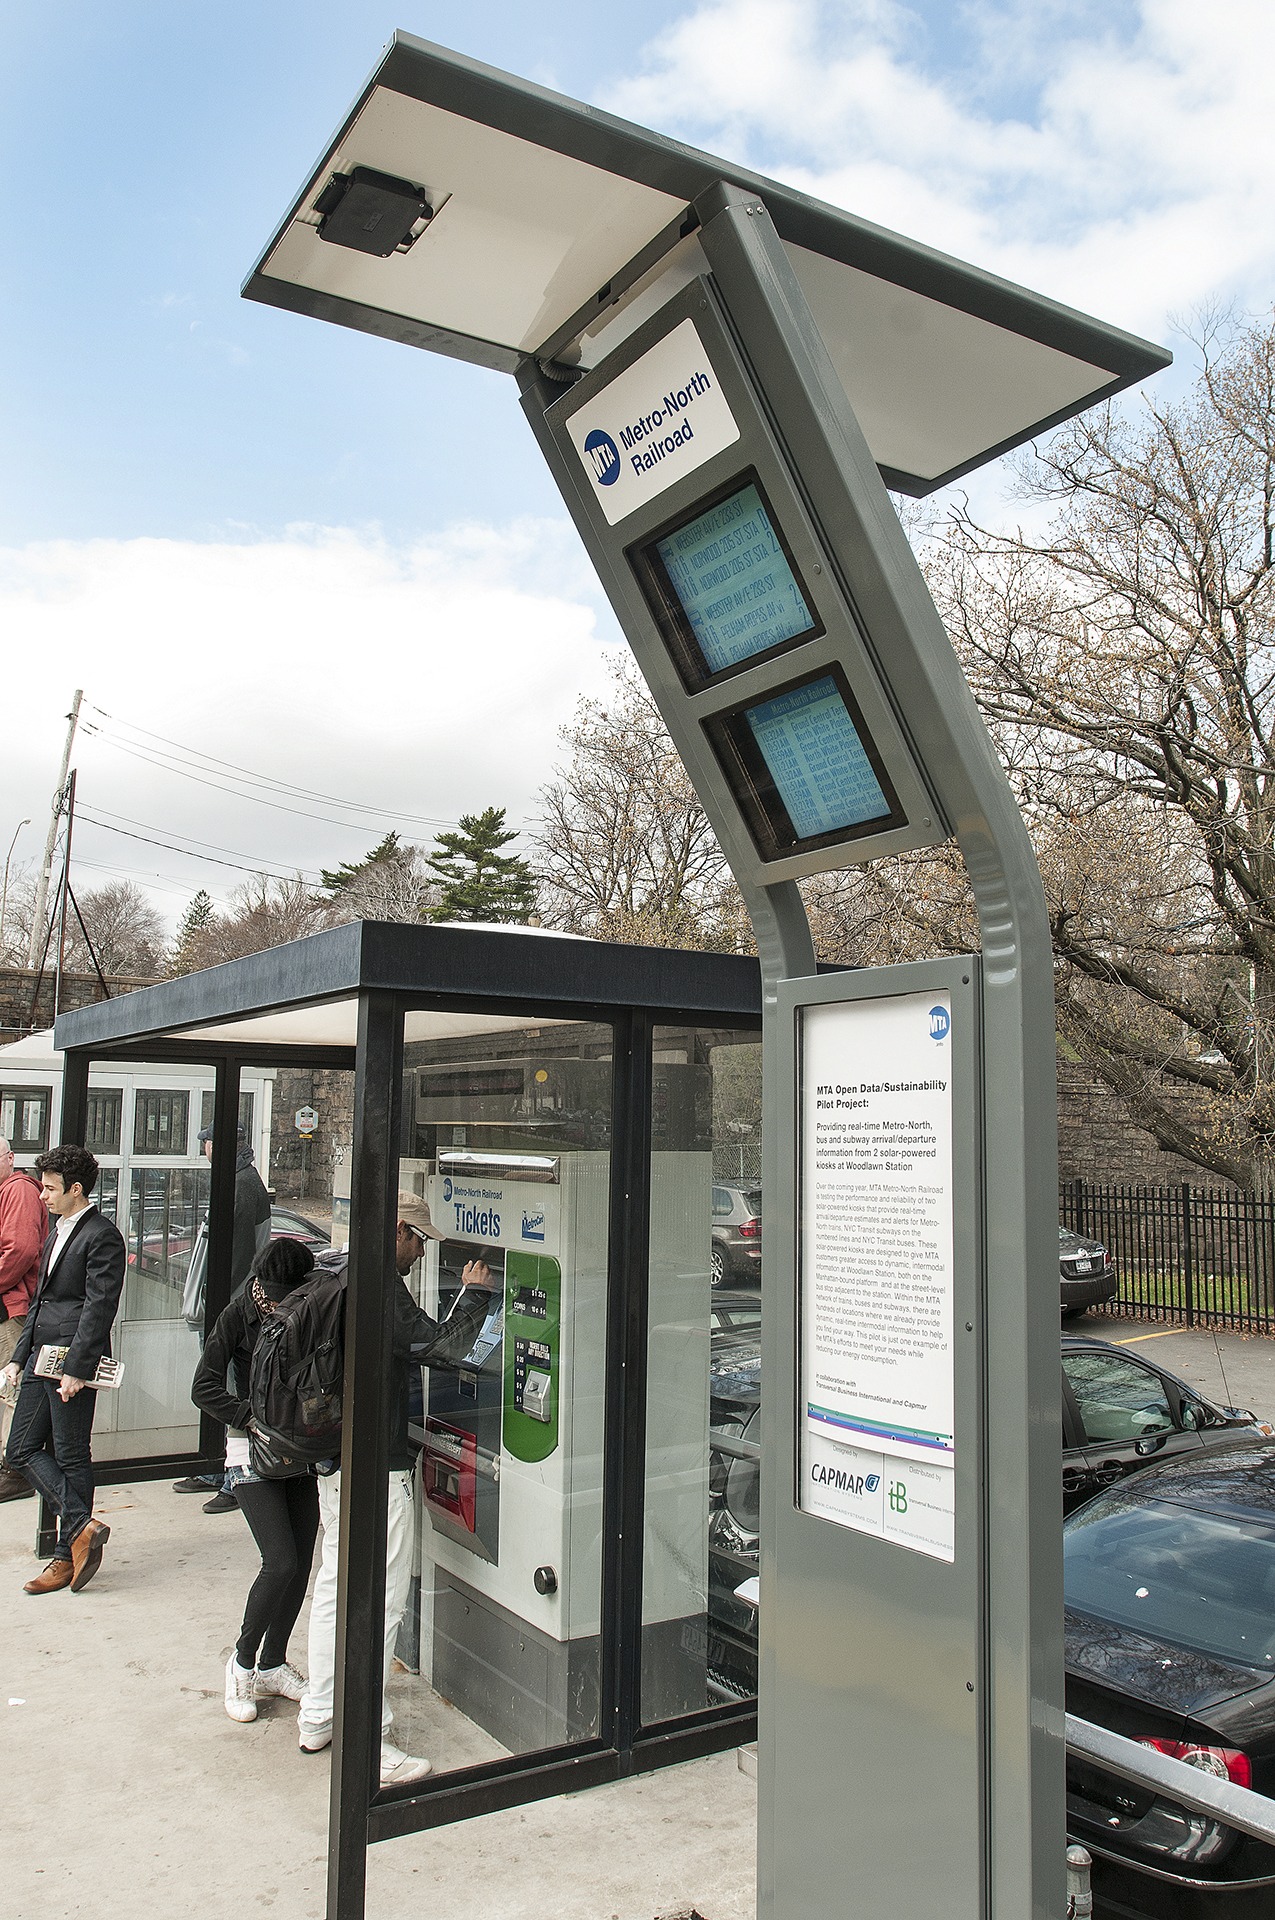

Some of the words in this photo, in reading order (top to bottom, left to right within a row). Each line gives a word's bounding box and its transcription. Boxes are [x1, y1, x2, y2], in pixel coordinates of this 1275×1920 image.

[619, 372, 711, 450] Metro-North
[630, 418, 694, 476] Railroad
[585, 443, 616, 481] MTA
[675, 524, 703, 551] WEBSTER
[719, 506, 734, 524] 233
[732, 500, 744, 515] ST
[690, 542, 721, 569] NORWOOD
[720, 534, 735, 552] 205
[734, 528, 745, 544] ST
[743, 520, 758, 539] STA
[700, 564, 730, 590] NORWOOD
[729, 556, 744, 574] 205
[743, 550, 755, 566] ST
[752, 543, 768, 561] STA
[705, 596, 734, 621] WEBSTER
[750, 579, 766, 597] 233
[764, 574, 776, 590] ST
[721, 618, 746, 639] PELHAM
[766, 602, 778, 617] AV
[771, 692, 808, 714] Metro-North
[808, 681, 835, 699] Railroad
[817, 1086, 834, 1095] MTA
[836, 1085, 858, 1096] Open
[860, 1080, 947, 1093] Data/Sustainability
[816, 1100, 834, 1109] Pilot
[836, 1099, 869, 1110] Project:
[816, 1122, 846, 1132] Providing
[848, 1122, 880, 1130] real-time
[882, 1120, 932, 1131] Metro-North,
[816, 1136, 828, 1144] bus
[829, 1136, 841, 1144] and
[842, 1136, 870, 1145] subway
[872, 1134, 936, 1145] arrival/departure
[816, 1148, 854, 1157] information
[854, 1148, 872, 1157] from
[873, 1148, 878, 1157] 2
[880, 1148, 936, 1158] solar-powered
[816, 1161, 836, 1170] kiosks
[846, 1162, 884, 1170] Woodlawn
[885, 1162, 912, 1171] Station
[454, 1186, 481, 1198] Metro-North
[482, 1189, 502, 1200] Railroad
[918, 1185, 944, 1193] Railroad
[891, 1196, 916, 1205] reliability
[878, 1206, 898, 1214] provide
[900, 1207, 926, 1215] real-time
[454, 1203, 500, 1238] Tickets
[893, 1217, 909, 1225] alerts
[920, 1218, 940, 1226] Metro-
[876, 1227, 901, 1236] subways
[877, 1236, 896, 1245] Transit
[896, 1239, 916, 1247] buses.
[918, 1240, 938, 1248] These
[876, 1248, 902, 1258] designed
[910, 1251, 924, 1260] give
[925, 1252, 940, 1260] MTA
[885, 1260, 911, 1269] dynamic,
[912, 1262, 945, 1272] intermodal
[875, 1268, 896, 1278] Station,
[898, 1270, 912, 1280] both
[922, 1273, 932, 1282] the
[900, 1282, 910, 1290] the
[912, 1284, 946, 1294] street-level
[872, 1290, 893, 1300] station.
[894, 1292, 913, 1302] Within
[914, 1295, 924, 1303] the
[926, 1296, 940, 1304] MTA
[514, 1302, 526, 1311] COINS
[872, 1301, 882, 1309] and
[884, 1303, 911, 1314] subways,
[912, 1306, 929, 1314] there
[930, 1308, 940, 1316] are
[894, 1315, 916, 1326] already
[916, 1318, 940, 1327] provide
[888, 1324, 920, 1335] information
[930, 1330, 944, 1340] help
[869, 1332, 880, 1341] pilot
[888, 1335, 898, 1344] just
[912, 1340, 940, 1350] example
[874, 1345, 887, 1353] your
[888, 1347, 906, 1356] needs
[908, 1350, 924, 1358] while
[44, 1348, 57, 1374] DAILY
[861, 1353, 898, 1366] consumption.
[820, 1374, 846, 1386] collaboration
[838, 1386, 858, 1397] Business
[859, 1392, 892, 1404] International
[892, 1398, 903, 1406] and
[904, 1400, 927, 1411] Capmar
[832, 1444, 852, 1455] Designed
[852, 1450, 858, 1458] by
[812, 1464, 864, 1496] CAPMAR
[909, 1466, 934, 1478] Distributed
[936, 1474, 942, 1482] by
